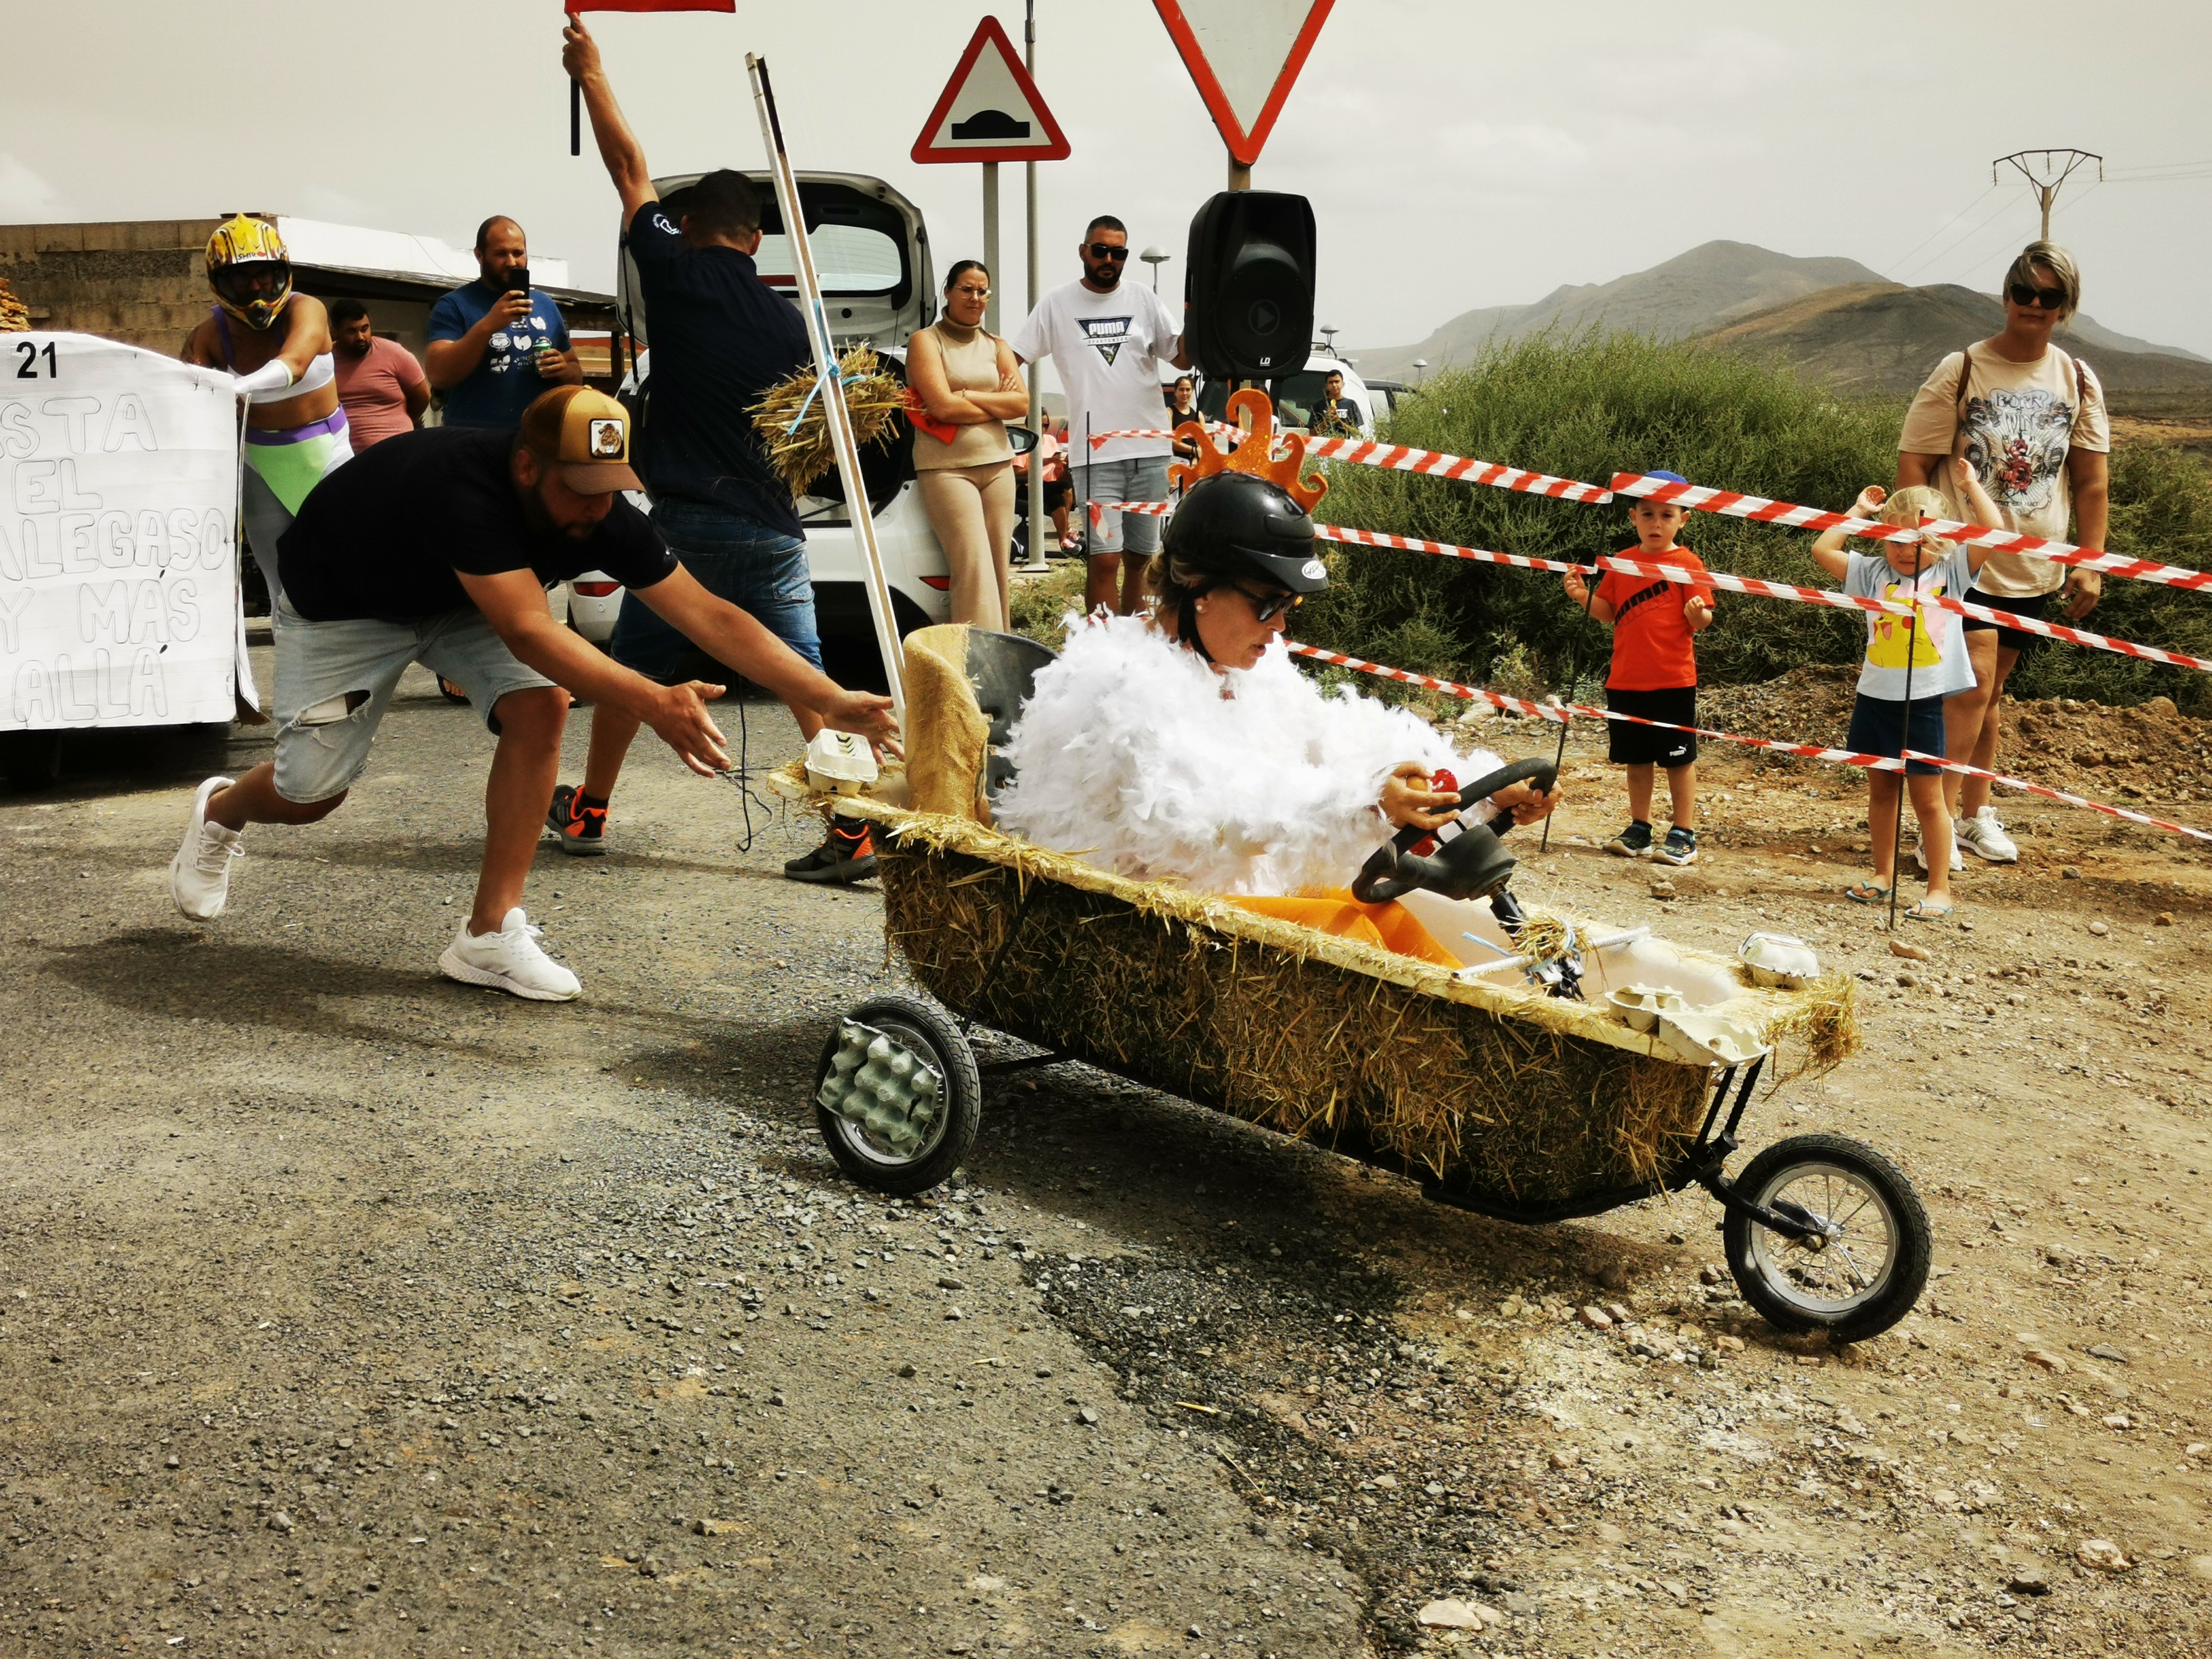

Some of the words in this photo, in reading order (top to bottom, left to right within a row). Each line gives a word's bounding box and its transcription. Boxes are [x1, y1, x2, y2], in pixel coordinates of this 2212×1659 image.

[1088, 321, 1125, 335] PUMA
[16, 341, 57, 379] 21
[0, 393, 158, 459] STA
[12, 458, 103, 515] EL
